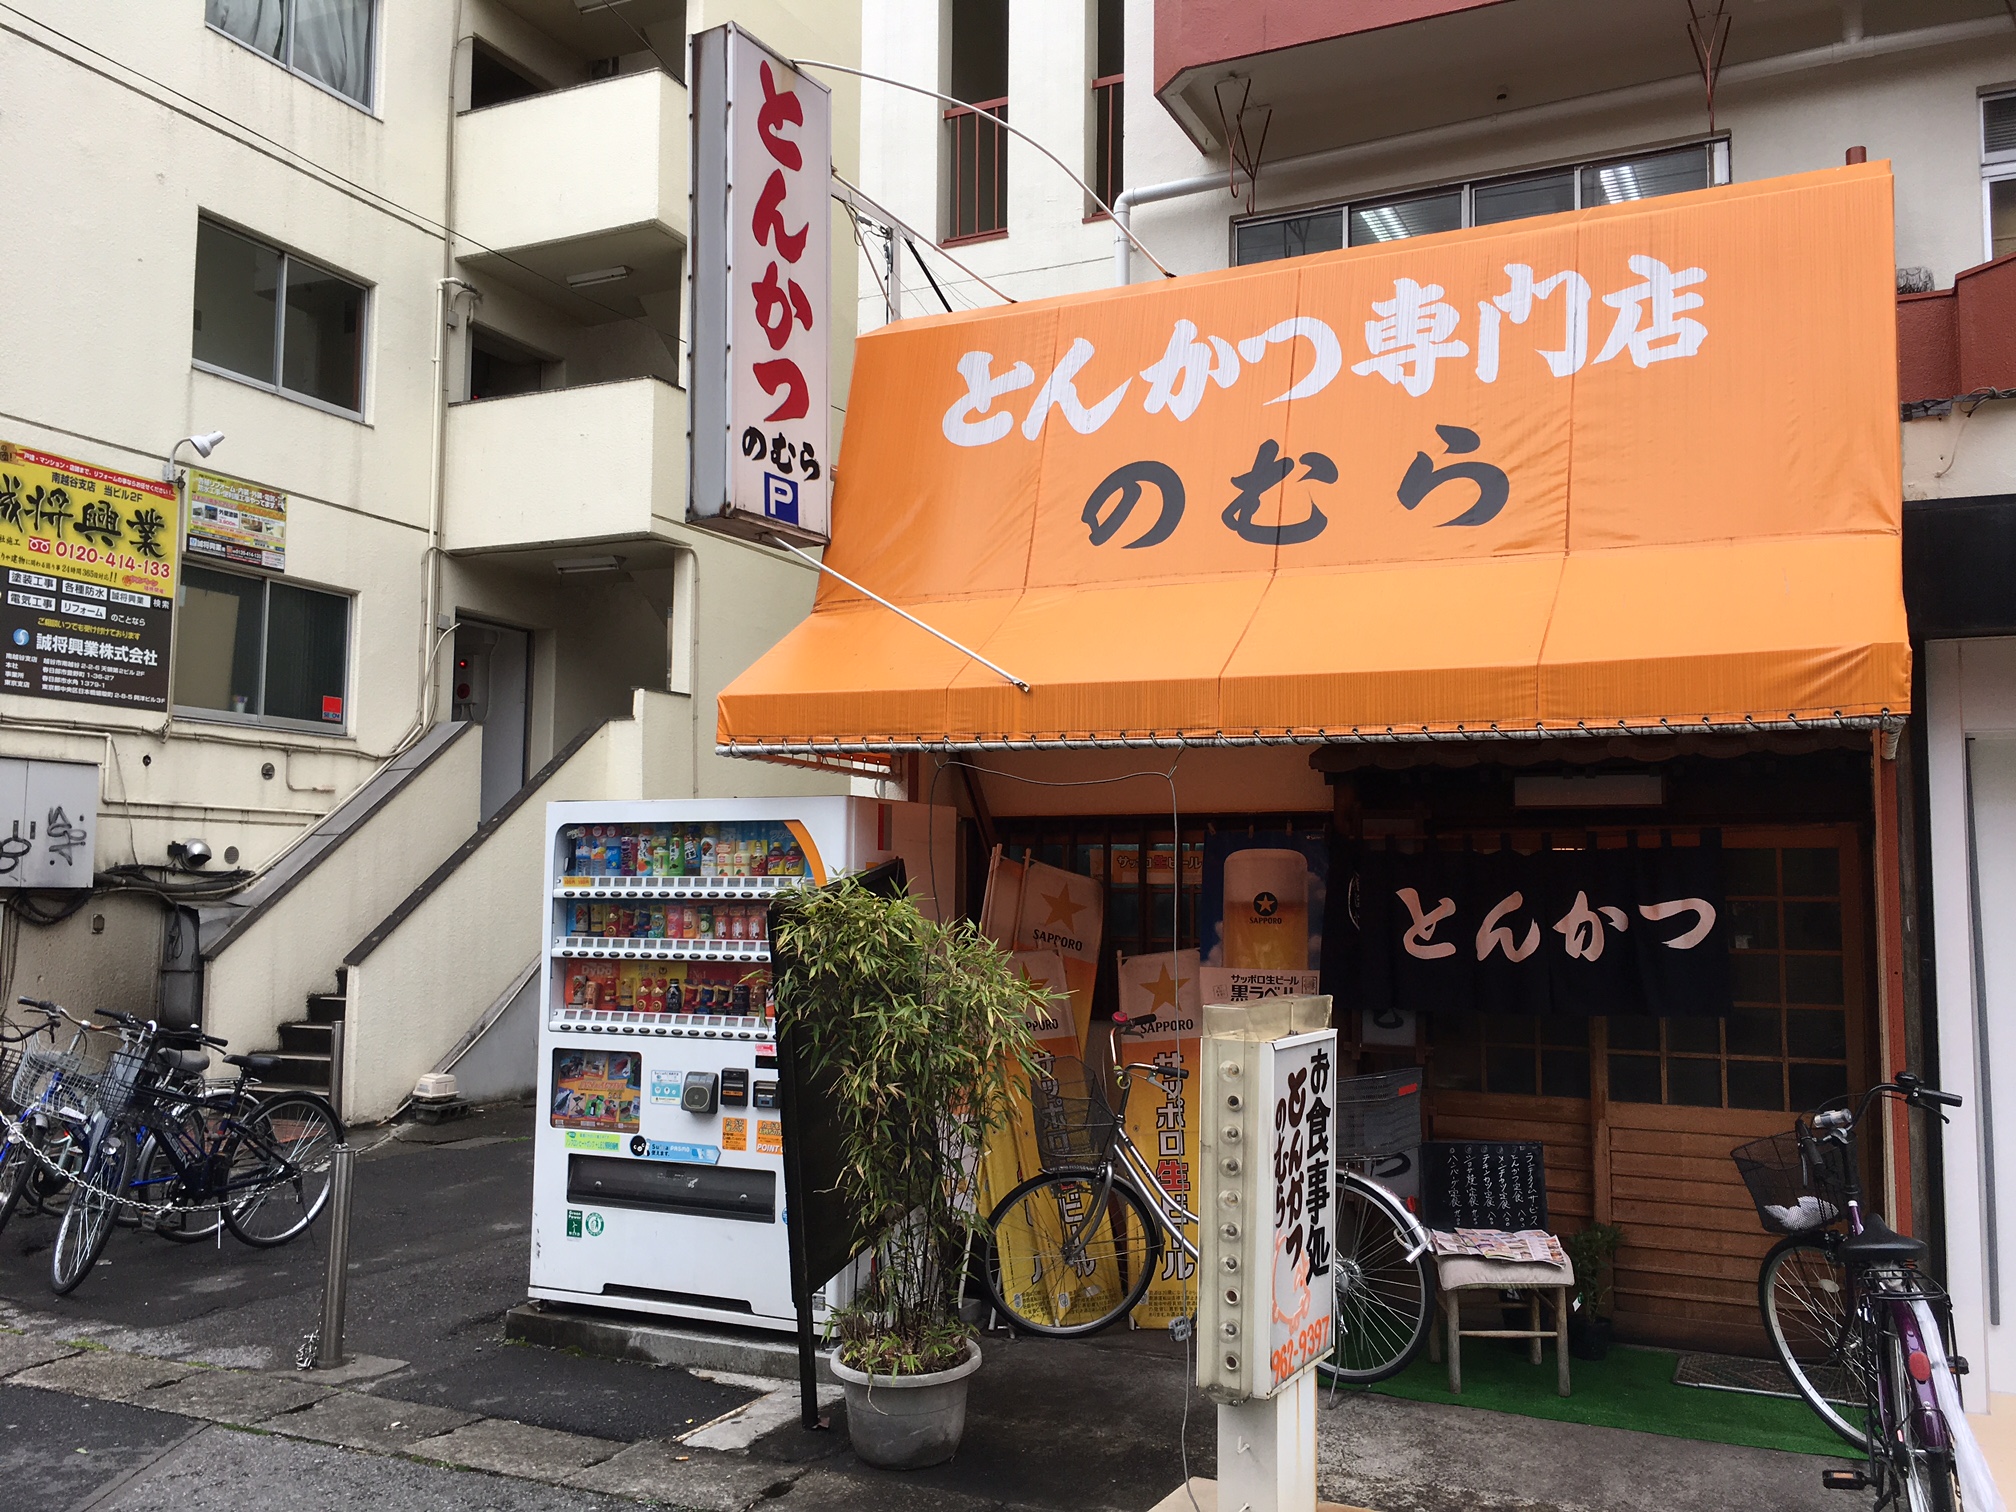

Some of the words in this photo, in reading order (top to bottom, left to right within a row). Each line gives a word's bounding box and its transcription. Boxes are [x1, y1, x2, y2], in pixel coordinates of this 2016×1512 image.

[752, 59, 813, 422] とんかつ
[942, 254, 1708, 447] とんかつ専門店
[742, 426, 821, 482] のむら
[52, 472, 96, 492] 南越谷支店
[104, 486, 143, 502] 当ビル2F
[769, 477, 794, 517] P
[1080, 424, 1510, 549] のむら
[56, 541, 170, 578] 0120-414-133
[11, 572, 54, 588] 塗装工事
[65, 582, 105, 598] 各種防水
[111, 591, 144, 605] 誠将興業
[153, 599, 170, 610] 検索
[10, 593, 53, 609] 電気工事
[64, 603, 103, 618] リフォーム
[111, 615, 146, 627] のことなら
[5, 662, 19, 670] 本社
[36, 633, 158, 666] 誠将興業株式会社
[1117, 855, 1202, 869] サッロ生ビール
[1032, 928, 1083, 952] SAPPORO
[1395, 886, 1717, 963] とんかつ
[581, 965, 612, 976] DyDo
[1231, 974, 1299, 985] サッポロ生ビール
[1140, 1018, 1194, 1034] SAPPORO
[757, 1143, 779, 1153] POINT
[1274, 1098, 1288, 1229] のむら
[1286, 1067, 1308, 1271] とんかつ
[1306, 1048, 1331, 1286] お食事処
[1271, 1316, 1330, 1384] 962-9397
